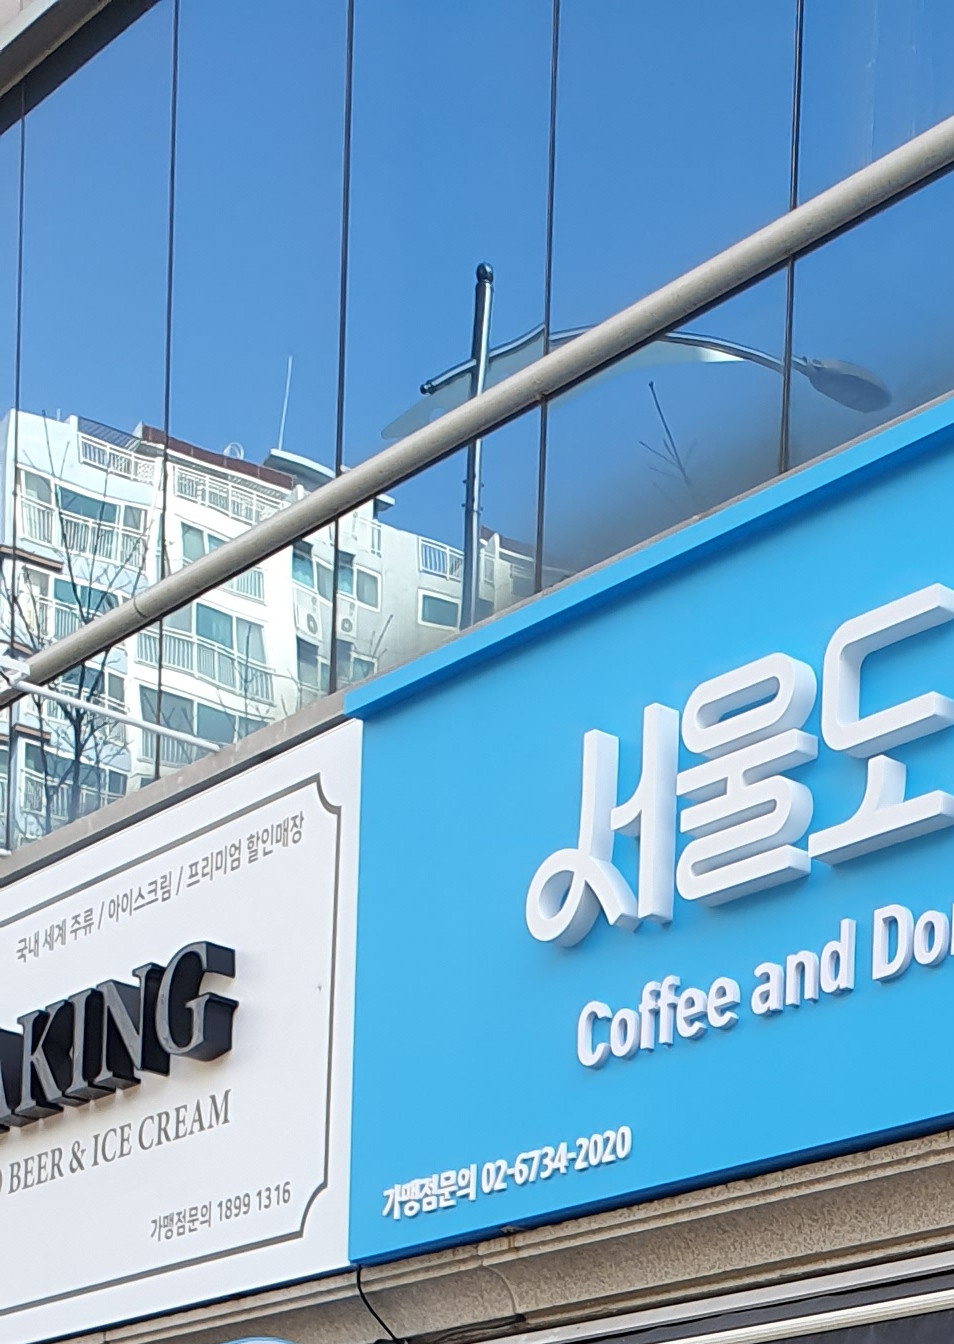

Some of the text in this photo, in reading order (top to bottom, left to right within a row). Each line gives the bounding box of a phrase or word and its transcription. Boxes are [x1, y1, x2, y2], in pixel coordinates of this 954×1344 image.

[16, 930, 39, 963] 국내
[42, 917, 67, 950] 세계
[70, 906, 94, 940] 주류
[107, 870, 172, 923] 아이스크림
[186, 839, 242, 888] 프리미엄
[246, 811, 305, 864] 할인매장
[0, 940, 239, 1133] KING
[577, 973, 741, 1069] Coffee
[750, 917, 856, 1018] and
[7, 1088, 232, 1194] BEER & ICE CREAM
[381, 1125, 633, 1221] 가맹점문의 02-6734-2020
[150, 1181, 292, 1242] 가맹점문의 1899 1316
